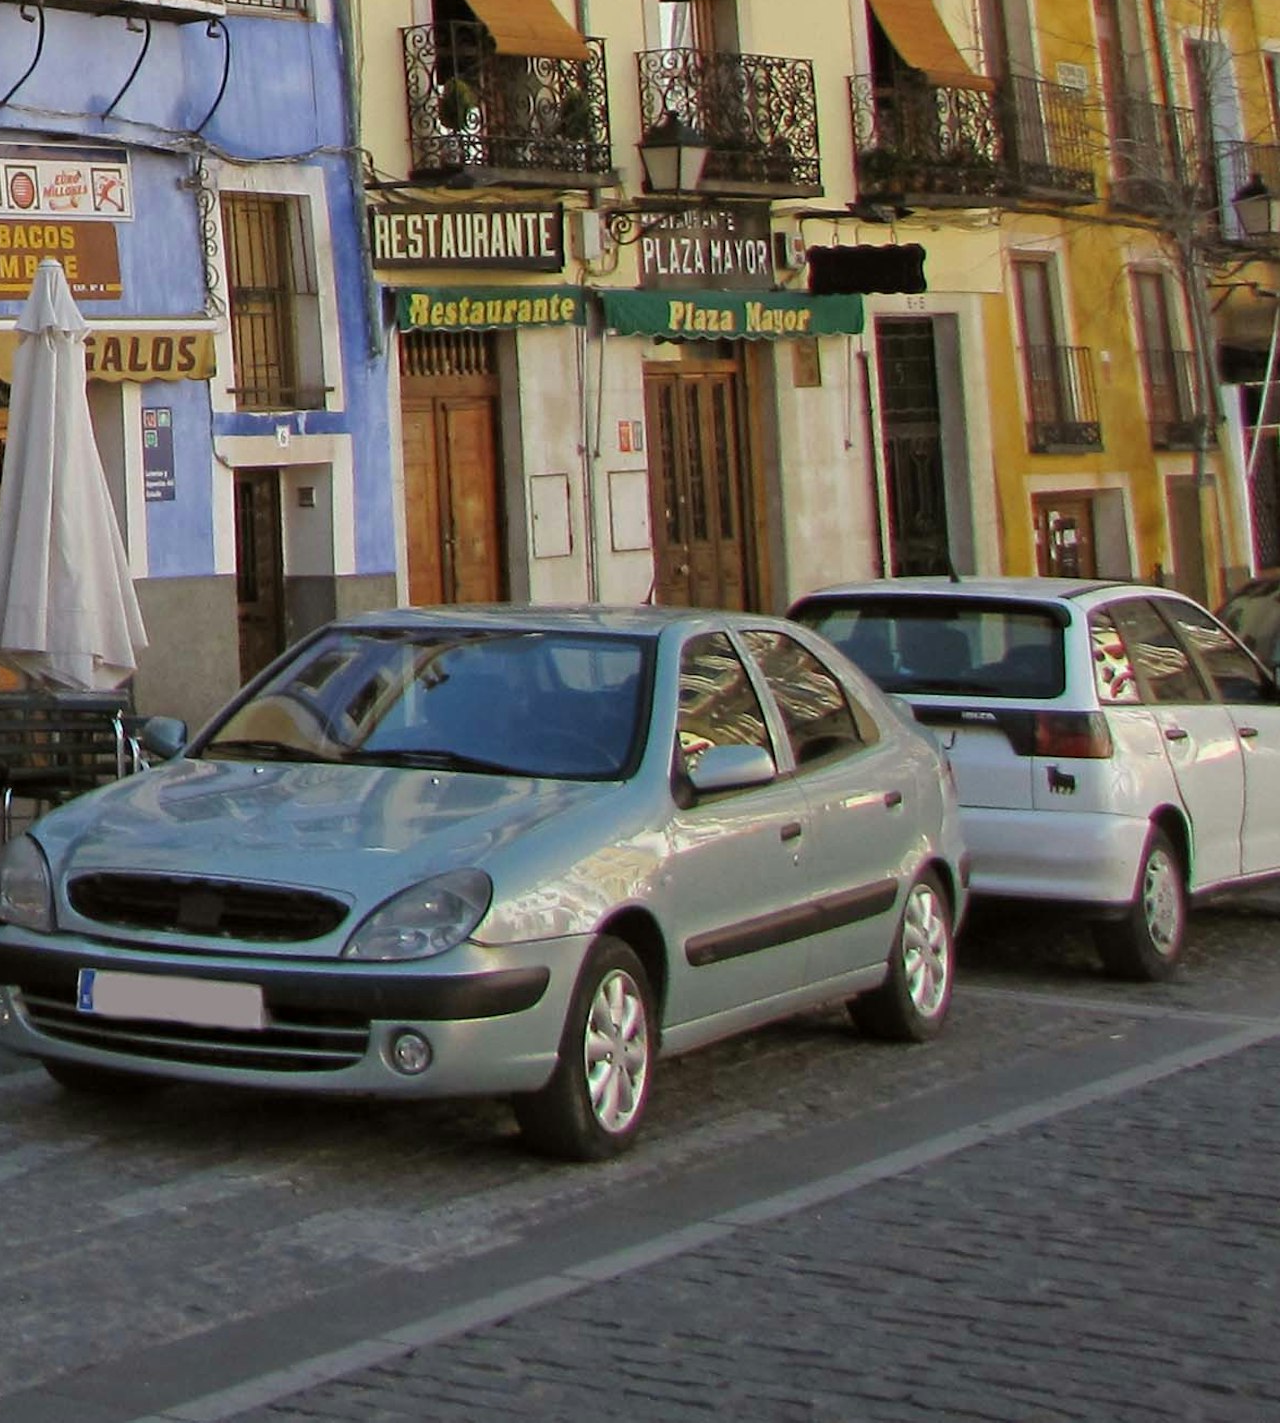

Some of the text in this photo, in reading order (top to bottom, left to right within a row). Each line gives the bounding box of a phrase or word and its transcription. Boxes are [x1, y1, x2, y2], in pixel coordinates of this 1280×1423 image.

[374, 212, 556, 259] RESTAURANTE
[643, 237, 767, 275] PLAZA MAYOR
[409, 293, 575, 326] Restaurante
[668, 301, 812, 333] Plaza Mayor
